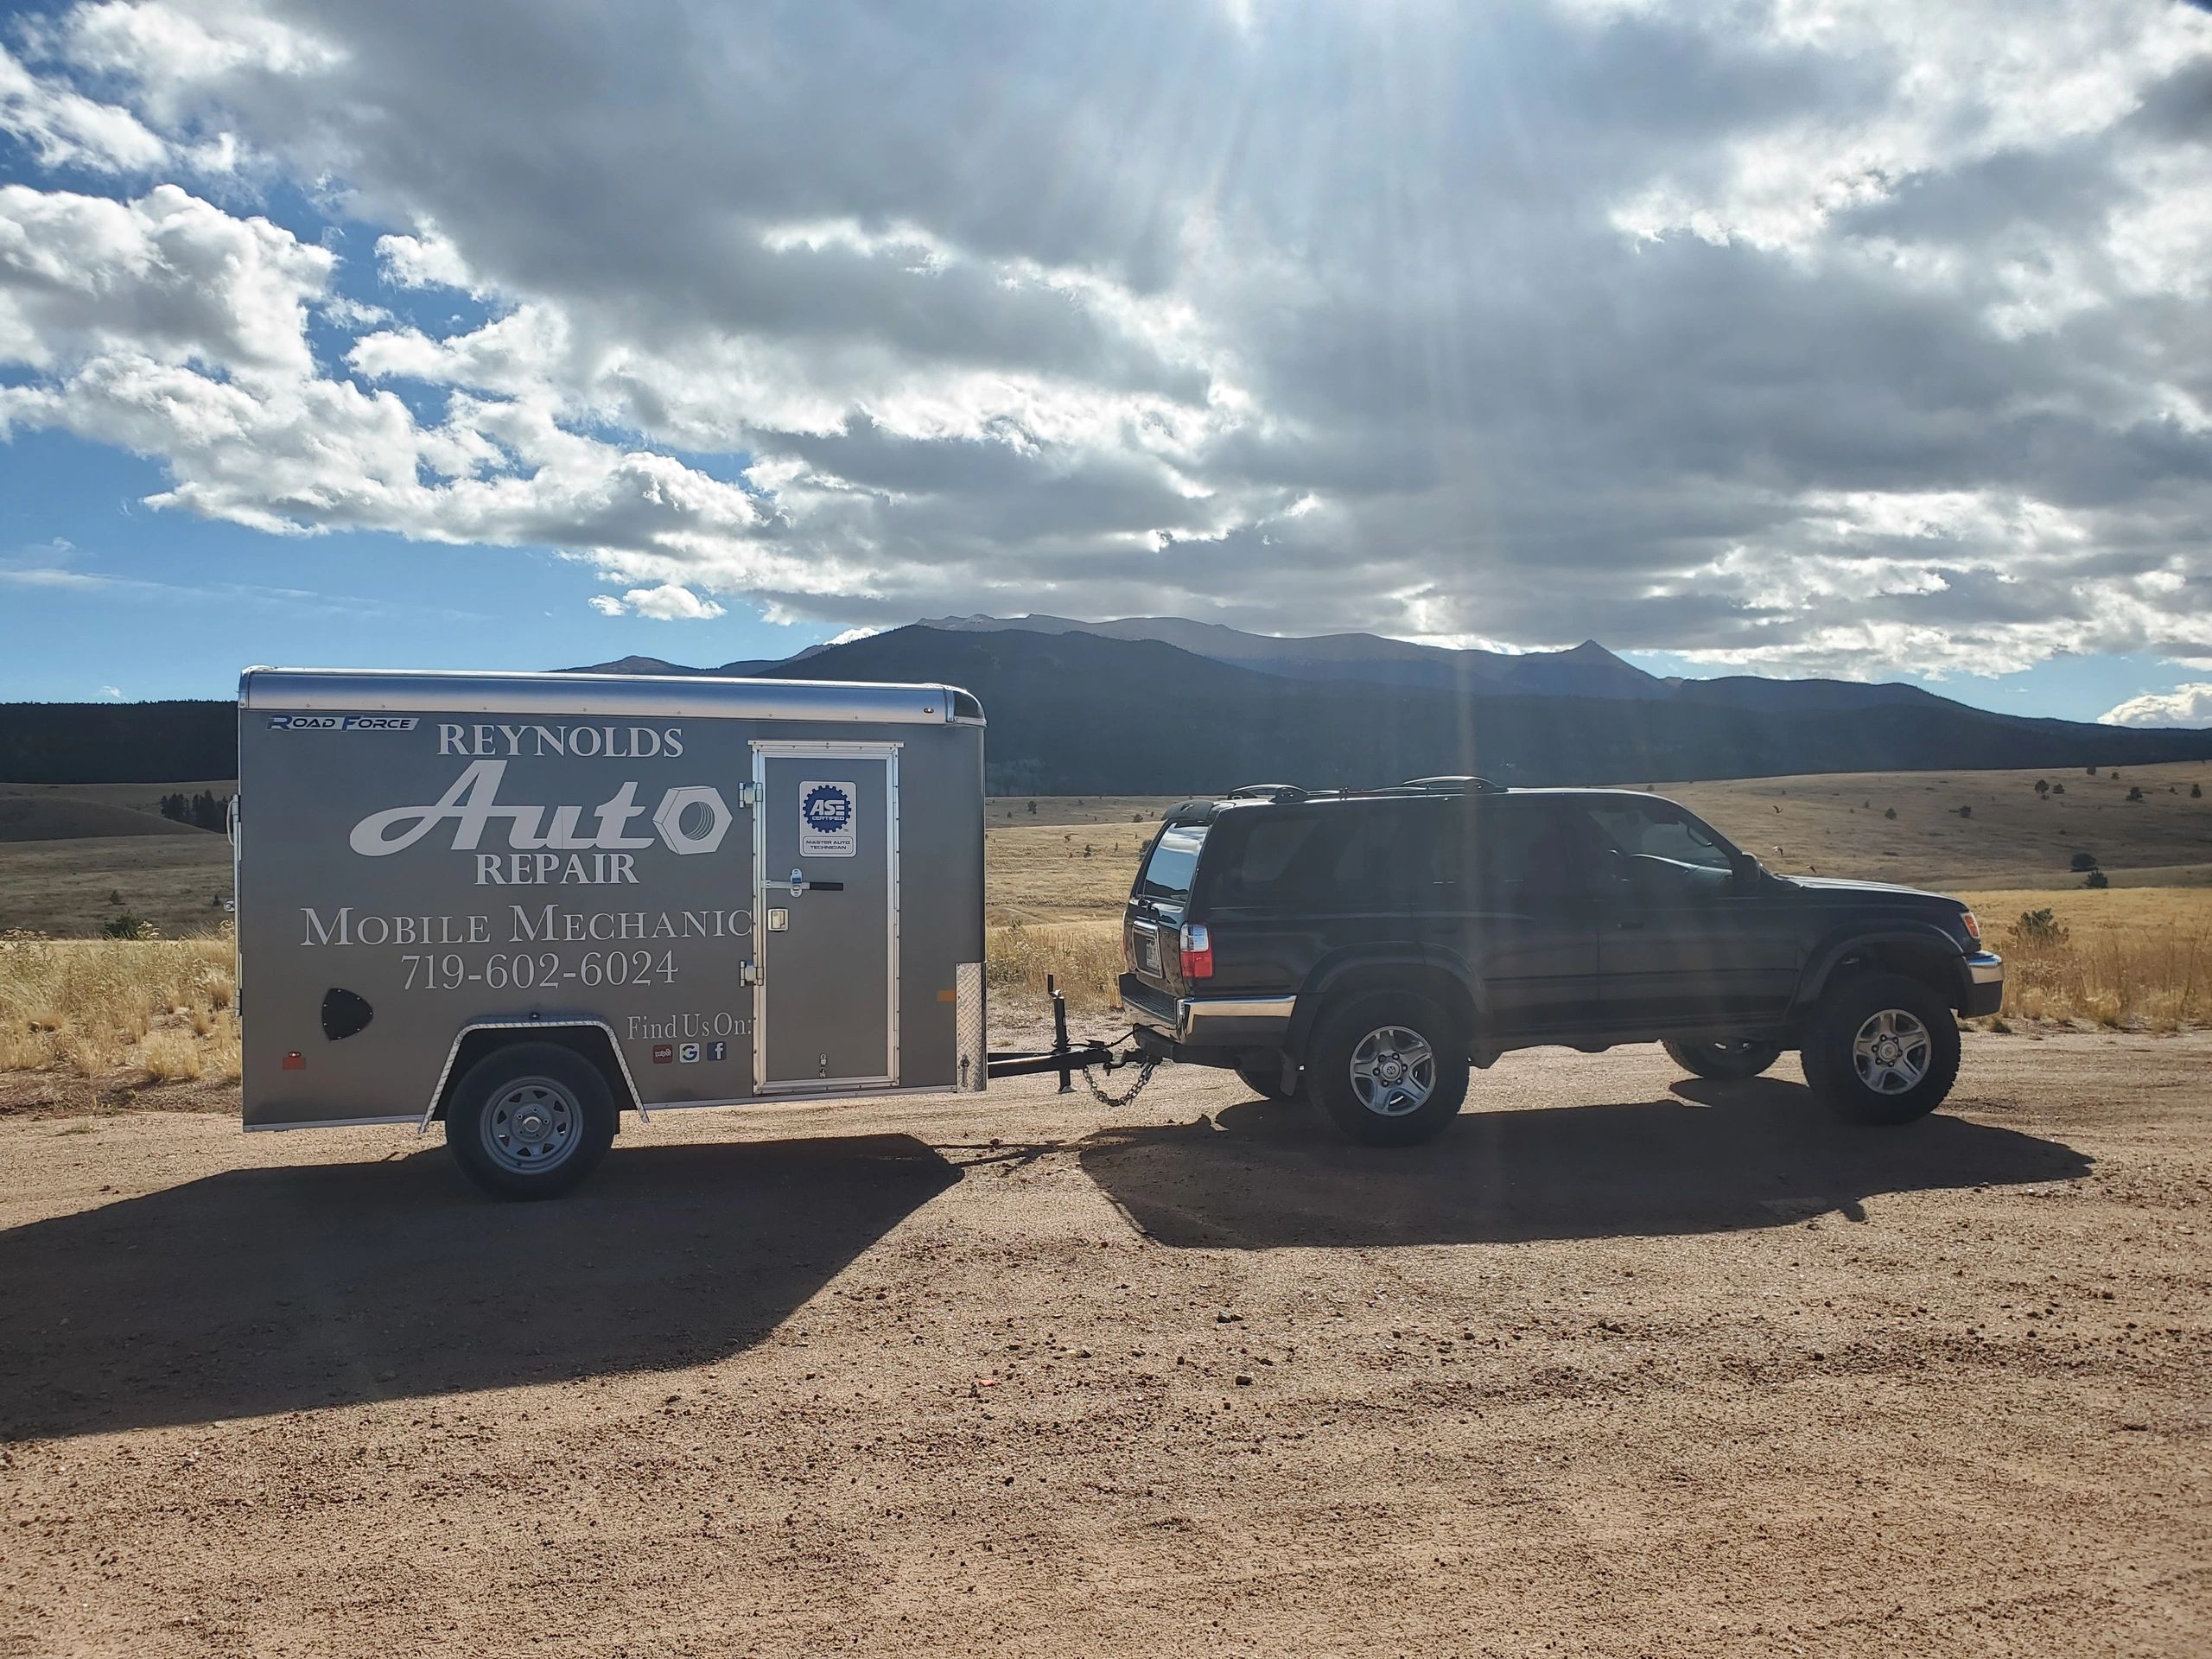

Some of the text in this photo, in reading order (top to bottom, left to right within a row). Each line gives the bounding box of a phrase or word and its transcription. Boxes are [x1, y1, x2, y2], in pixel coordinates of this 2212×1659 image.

[267, 715, 411, 731] ROAD FORCE
[436, 724, 683, 758] REYNOLDS
[810, 800, 844, 816] ASE
[474, 854, 640, 885] REPAIR
[300, 904, 753, 946] MOBILE MECHANIC
[400, 950, 678, 990] 719-602-6024
[627, 1012, 752, 1039] Find Us On:
